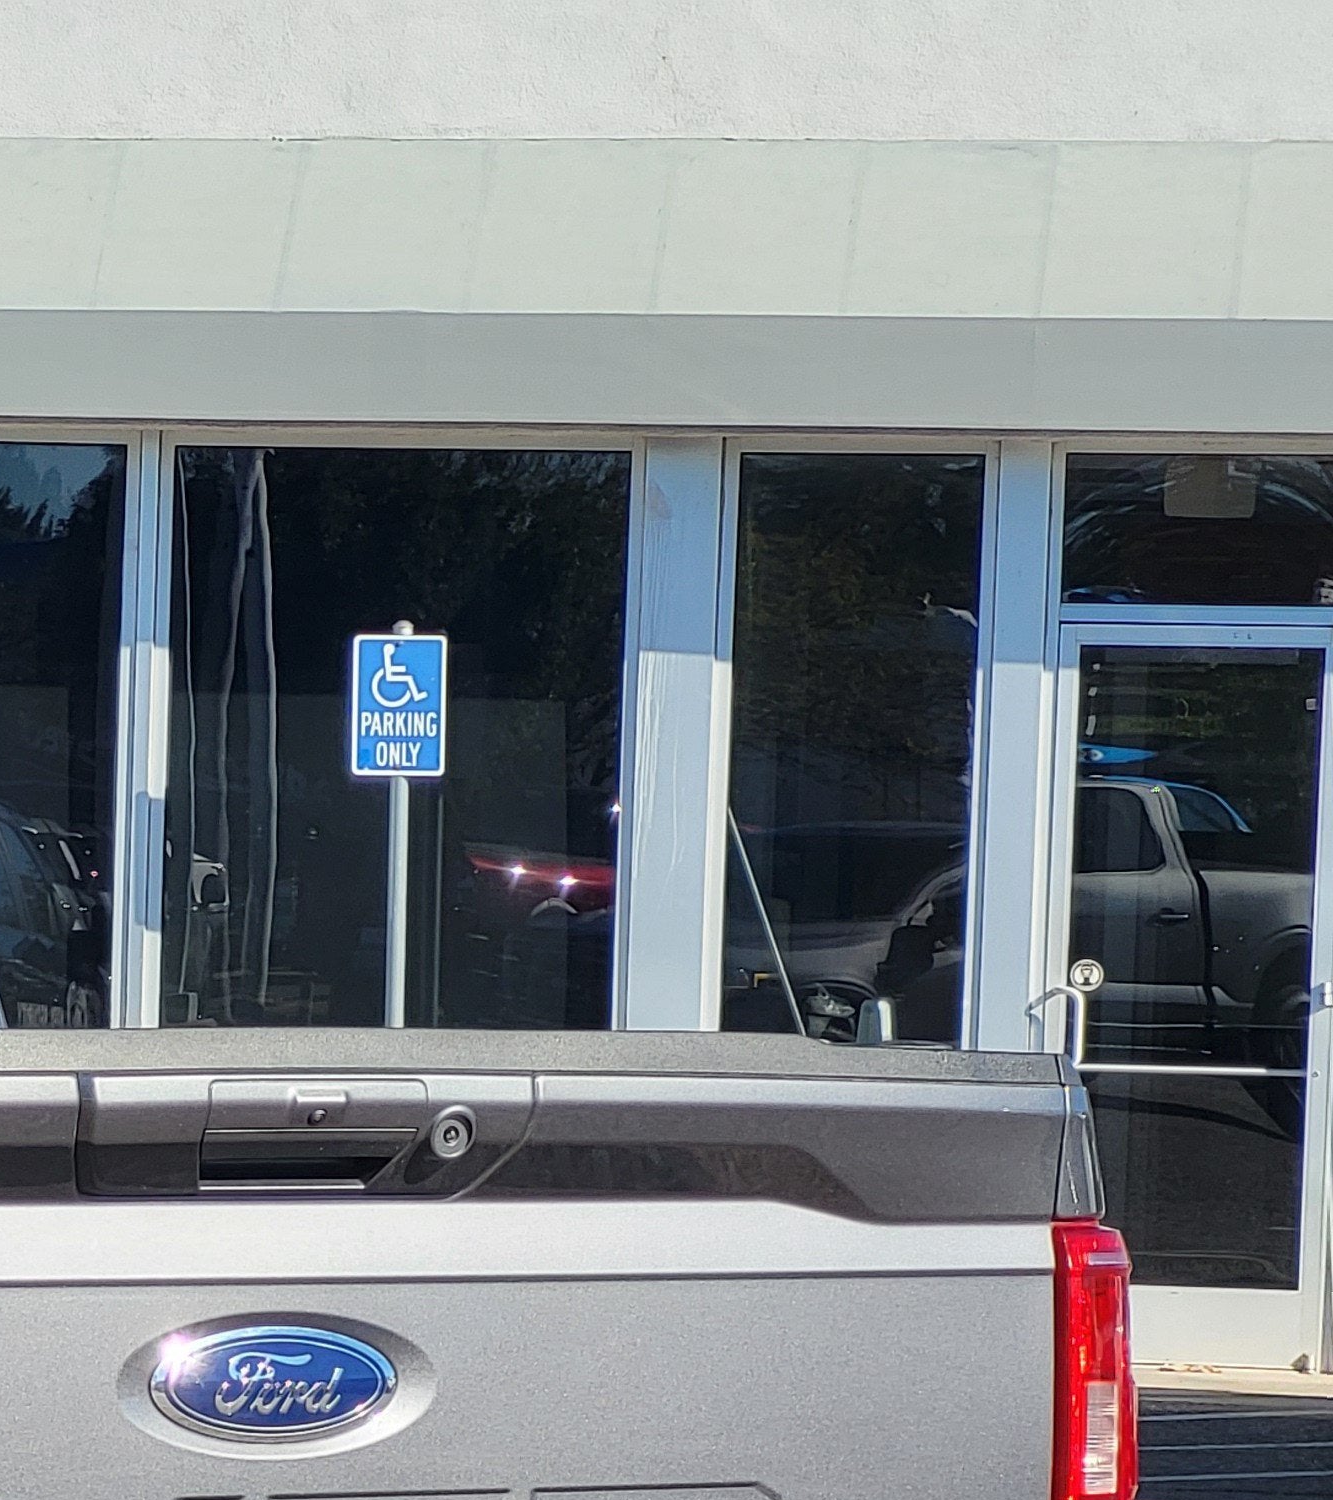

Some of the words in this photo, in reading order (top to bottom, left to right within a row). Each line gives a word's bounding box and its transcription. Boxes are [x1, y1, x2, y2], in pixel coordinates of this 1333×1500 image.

[361, 711, 438, 738] PARKING
[375, 741, 422, 767] ONLY
[214, 1351, 345, 1417] Ford
